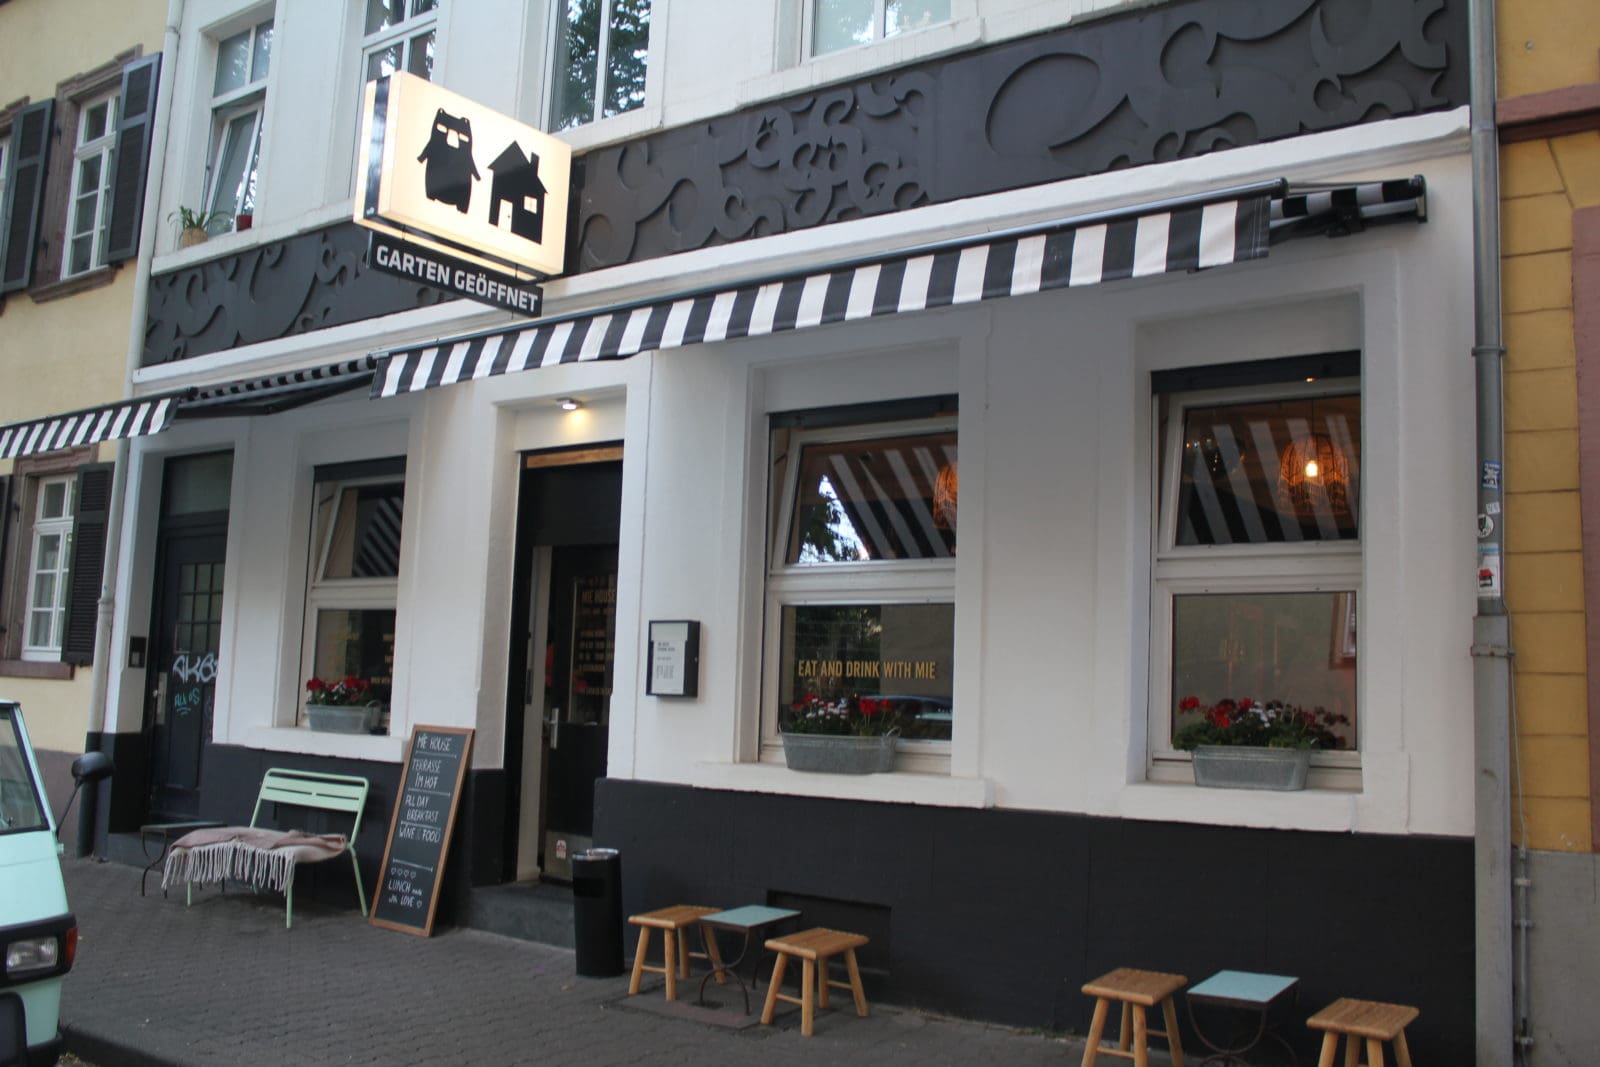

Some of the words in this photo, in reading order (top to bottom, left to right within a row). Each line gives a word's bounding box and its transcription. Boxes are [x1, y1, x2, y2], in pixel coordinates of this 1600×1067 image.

[376, 245, 450, 286] GARTEN
[454, 270, 538, 313] GEÖFFNET
[798, 659, 817, 677] EAT
[820, 660, 843, 677] AND
[846, 661, 880, 678] DRINK
[883, 661, 912, 679] WITH
[915, 662, 936, 680] MIE
[430, 736, 452, 752] HOUSE
[412, 758, 442, 774] TERRASSE
[405, 794, 415, 807] ALL
[416, 795, 430, 808] DAY
[406, 808, 439, 823] BREAKFAST
[399, 825, 416, 840] WINE
[422, 829, 441, 843] FOOD
[388, 879, 411, 893] LUNCH
[400, 895, 415, 908] LOVE
